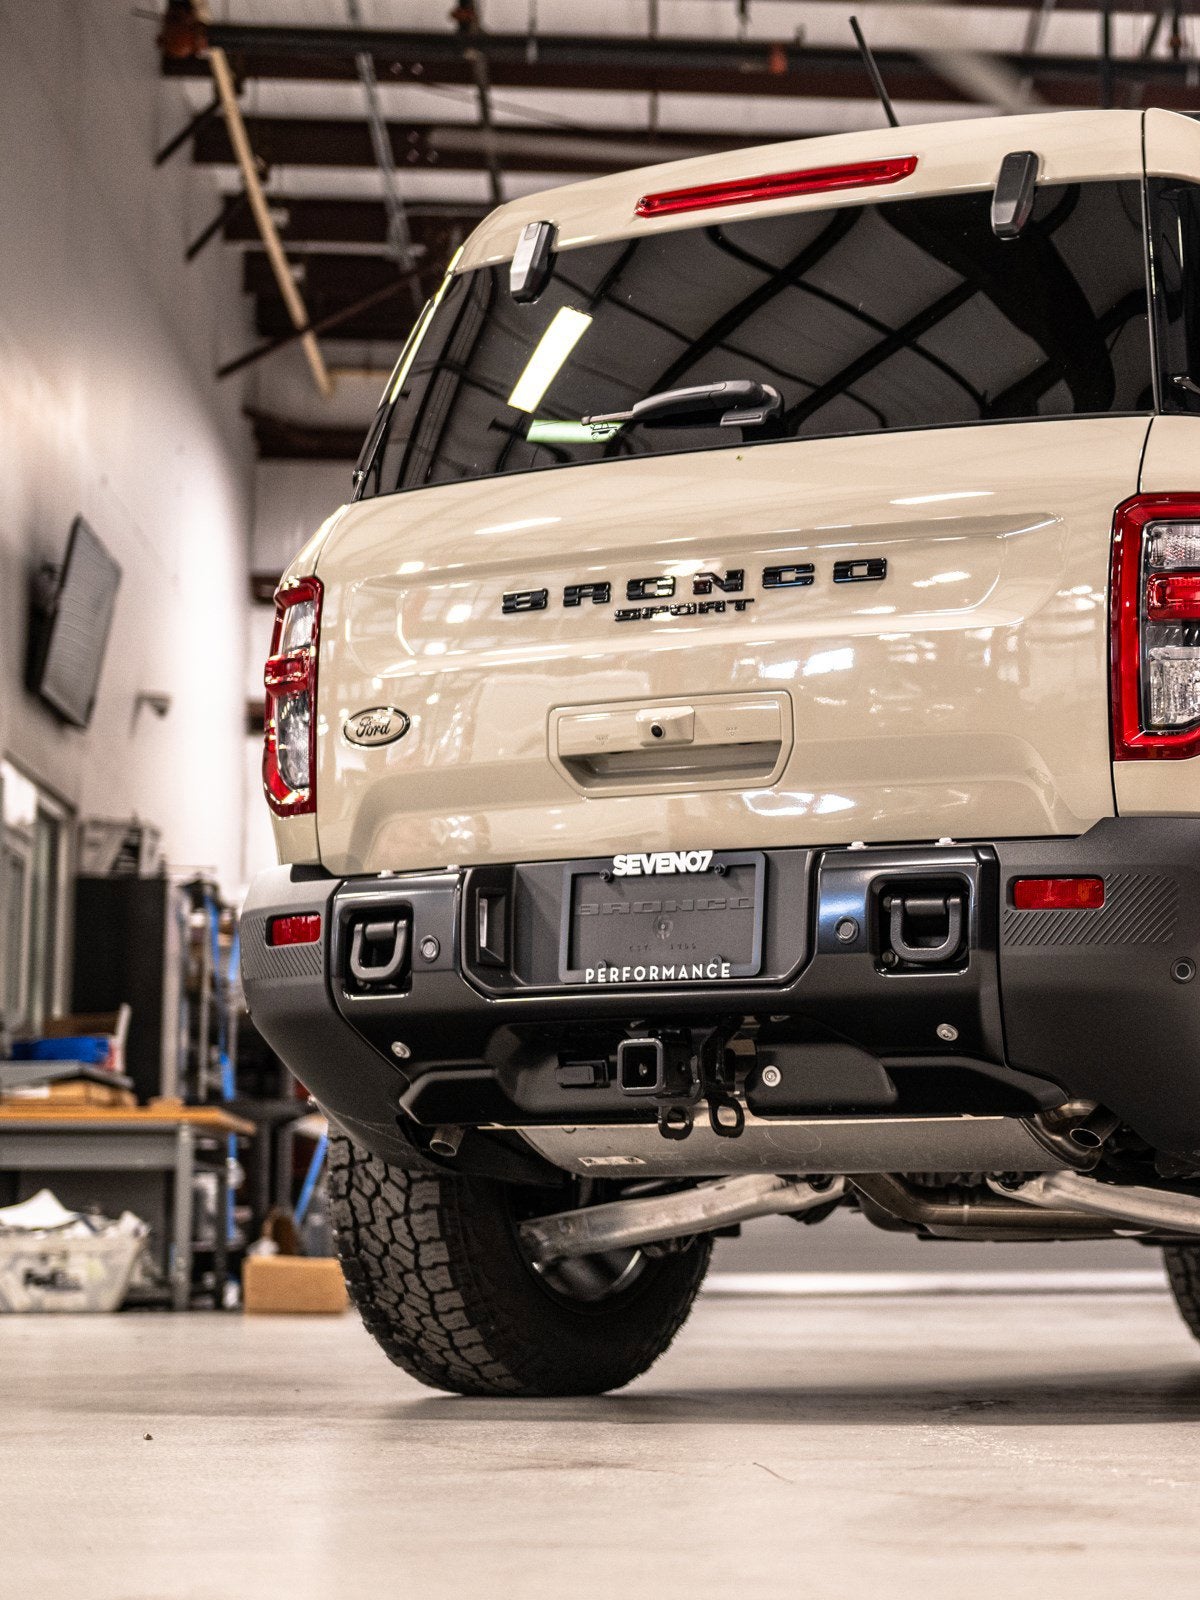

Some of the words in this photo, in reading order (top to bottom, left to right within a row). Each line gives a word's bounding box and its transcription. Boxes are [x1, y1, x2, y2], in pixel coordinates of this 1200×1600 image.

[502, 557, 888, 614] BRONCO
[614, 597, 755, 621] SPORT
[355, 715, 392, 738] Ford
[585, 962, 731, 983] PERFORMANCE
